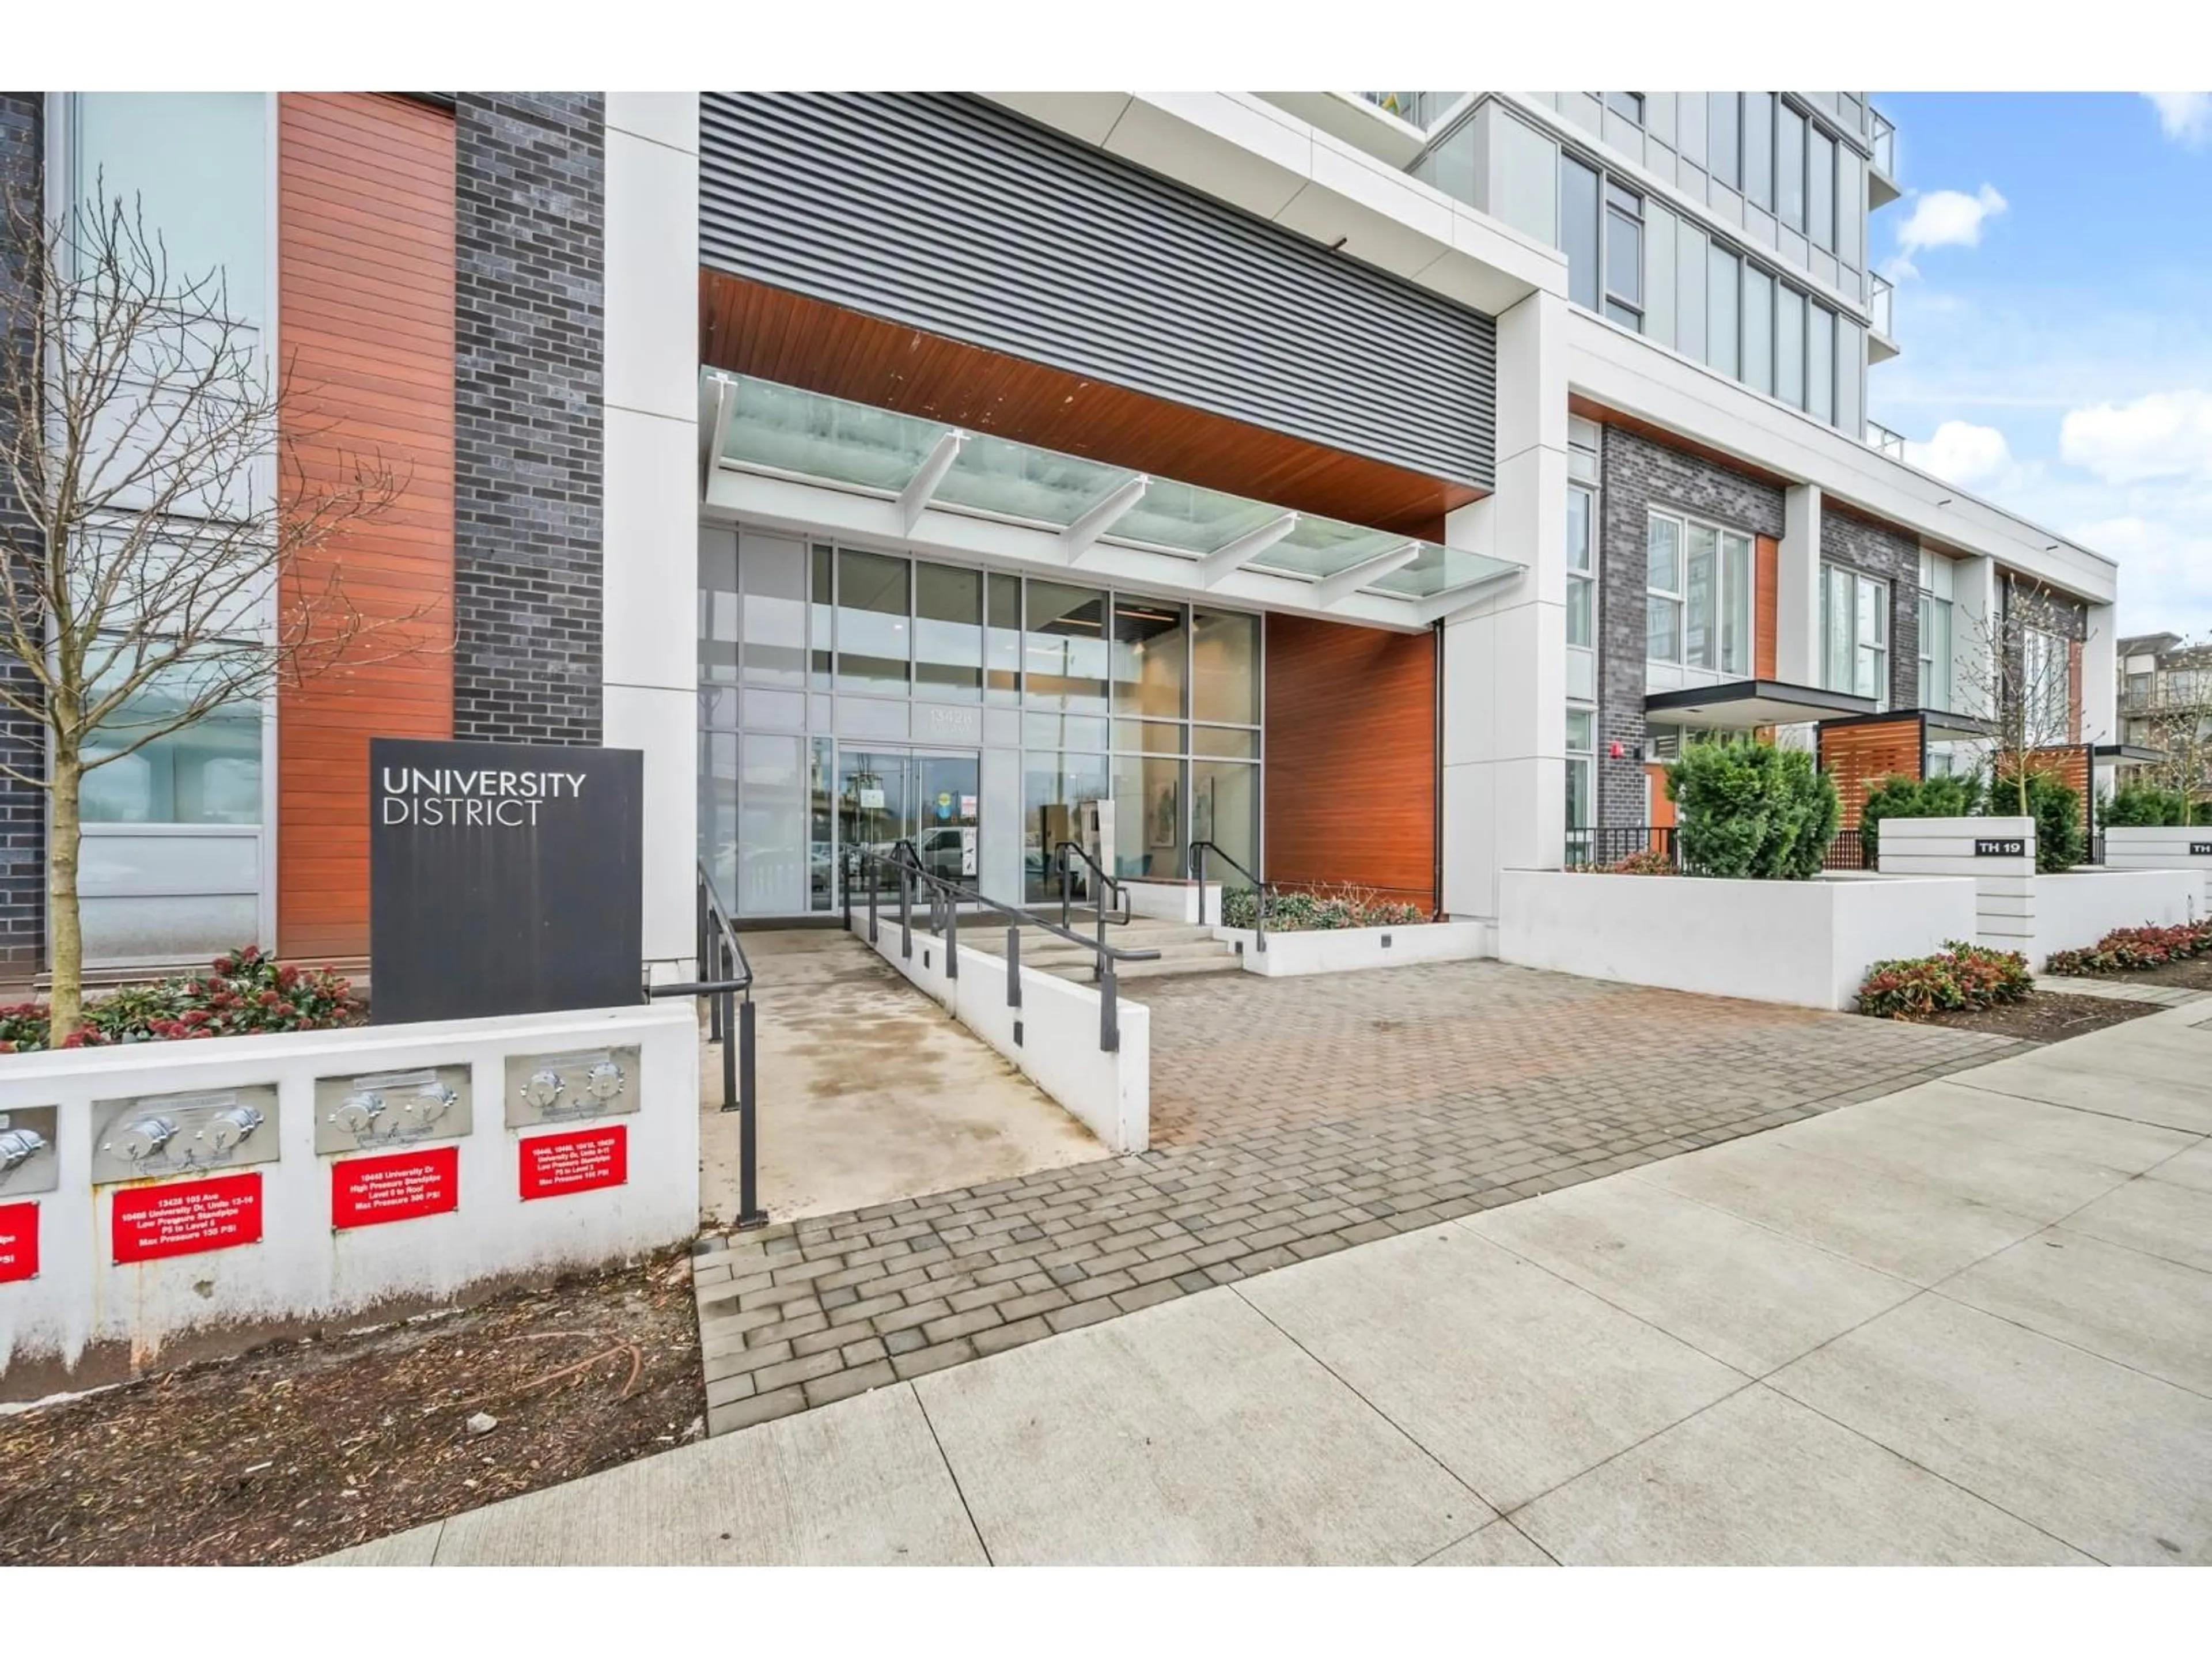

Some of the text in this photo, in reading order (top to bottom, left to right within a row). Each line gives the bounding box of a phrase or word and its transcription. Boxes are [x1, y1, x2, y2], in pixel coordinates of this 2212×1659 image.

[383, 767, 586, 797] UNIVERSITY
[383, 797, 543, 825] DISTRICT
[1979, 843, 2021, 853] TH 19
[551, 1160, 579, 1169] Pressure
[581, 1155, 611, 1164] Standpipe
[385, 1168, 423, 1179] University
[425, 1165, 434, 1173] Dr
[554, 1174, 583, 1183] Pressure
[350, 1175, 441, 1193] High Pressure Standpipe
[186, 1195, 200, 1204] 105
[202, 1194, 219, 1202] Ave
[369, 1190, 388, 1199] Level
[406, 1185, 423, 1194] Roof
[373, 1197, 408, 1207] Pressure
[426, 1191, 440, 1200] PSI
[149, 1206, 191, 1218] University
[207, 1200, 229, 1209] Units
[137, 1208, 239, 1229] Low Pressure Standpipe
[185, 1219, 207, 1230] Level
[139, 1238, 157, 1247] Max
[160, 1232, 200, 1243] Pressure
[221, 1224, 236, 1234] PSI
